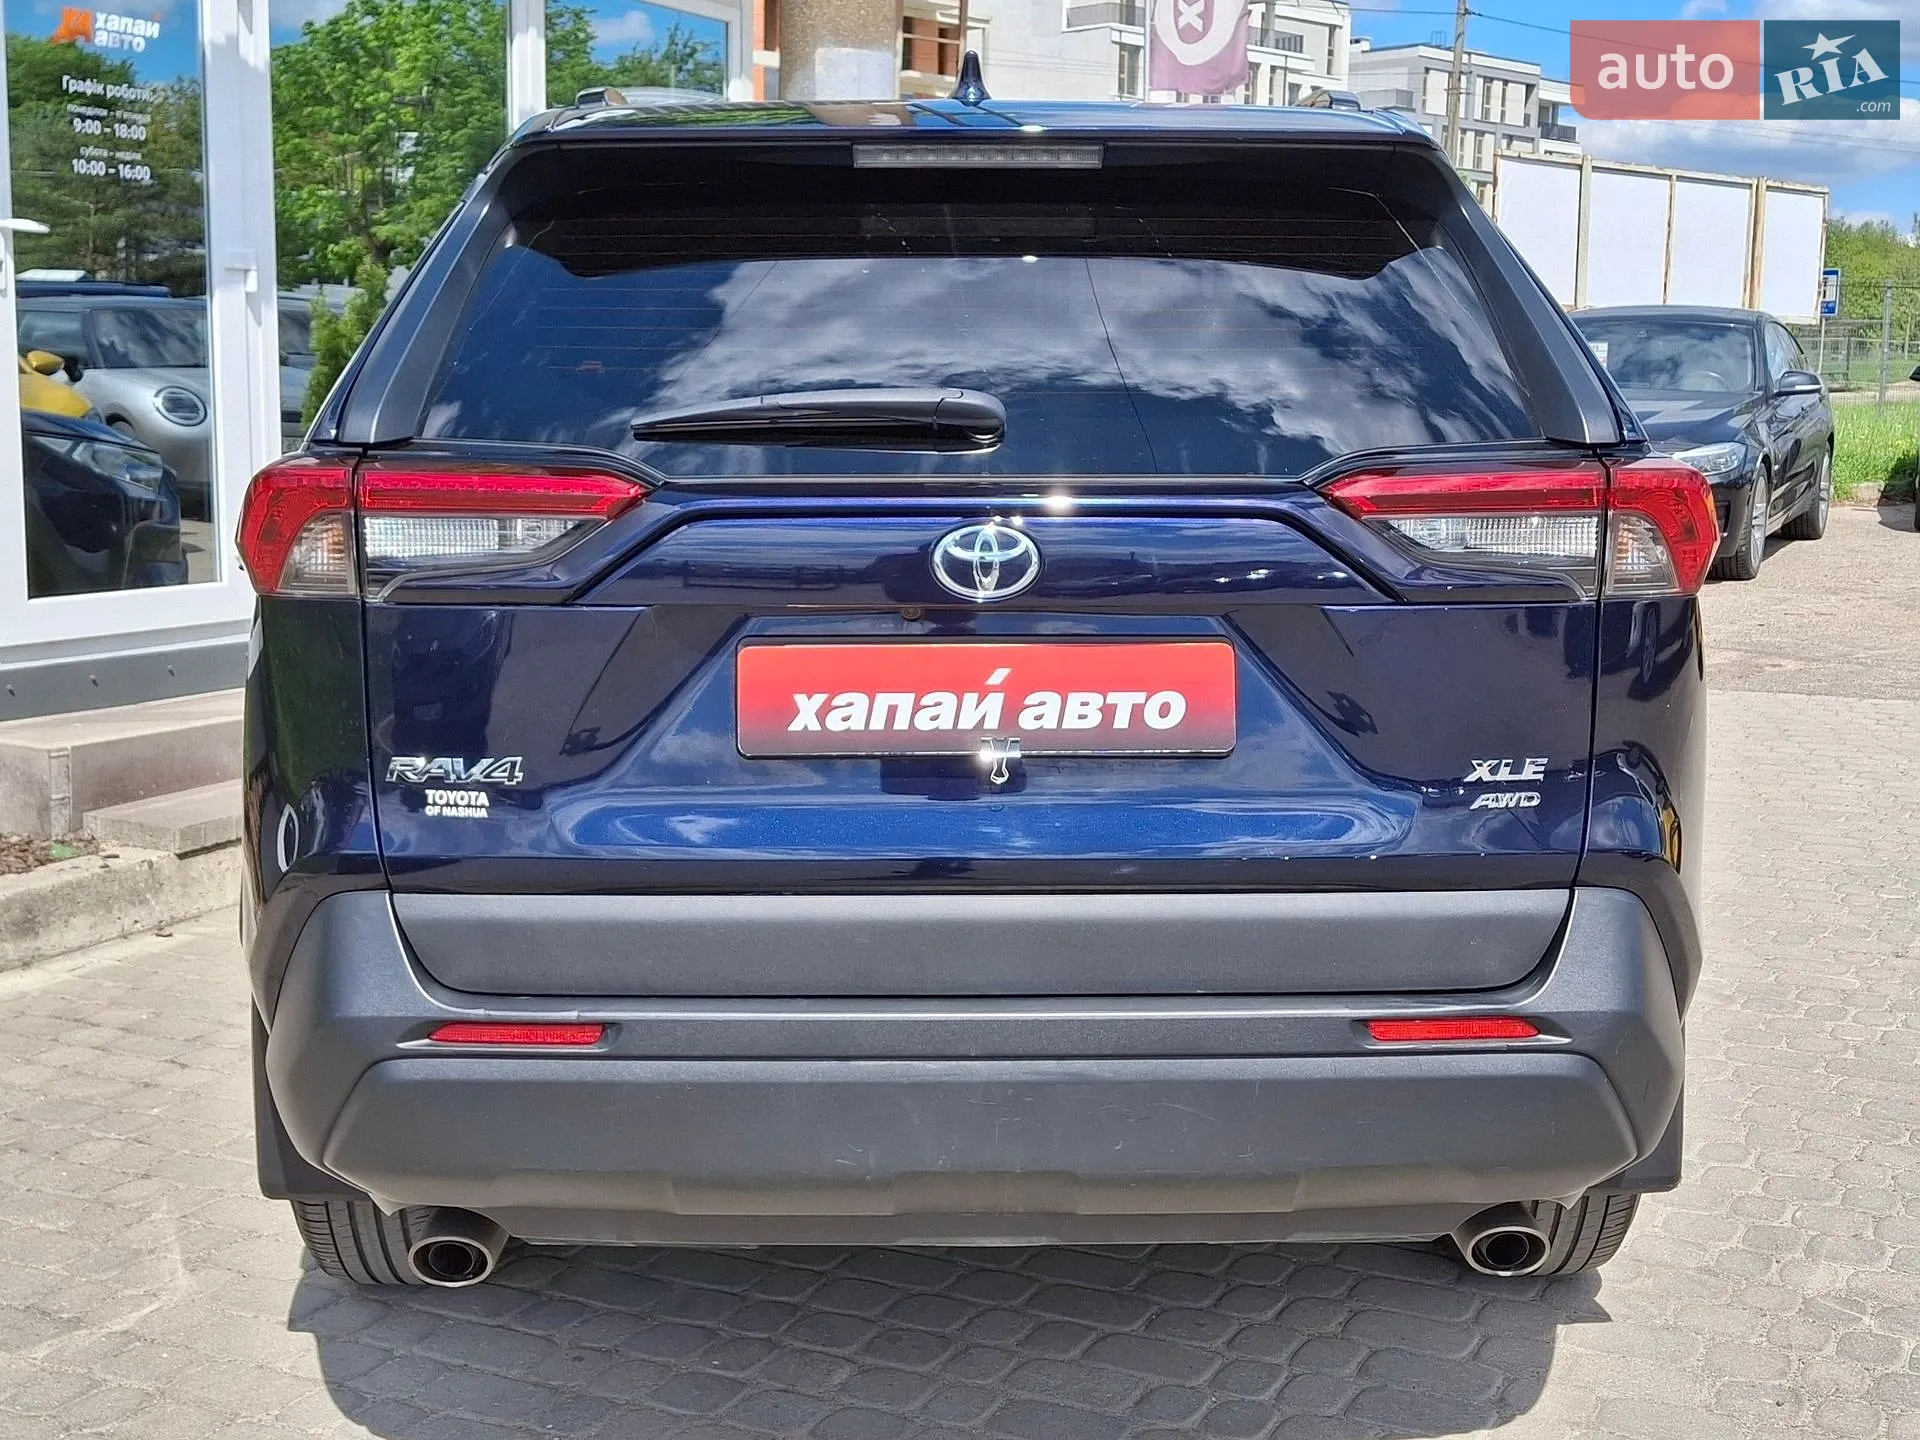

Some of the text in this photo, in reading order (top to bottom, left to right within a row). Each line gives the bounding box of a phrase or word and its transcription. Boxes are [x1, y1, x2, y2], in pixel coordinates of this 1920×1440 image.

[94, 29, 146, 53] авто
[62, 74, 105, 97] Графік
[73, 117, 102, 135] 9:00
[113, 122, 147, 141] 18:00
[72, 158, 106, 177] 10:00
[118, 163, 151, 181] 16:00
[1017, 690, 1187, 730] авто
[385, 755, 524, 786] RAV4
[1462, 757, 1549, 782] XLE
[424, 788, 490, 808] TOYOTA
[1469, 791, 1542, 810] AWD
[424, 804, 489, 819] OF NASHUA
